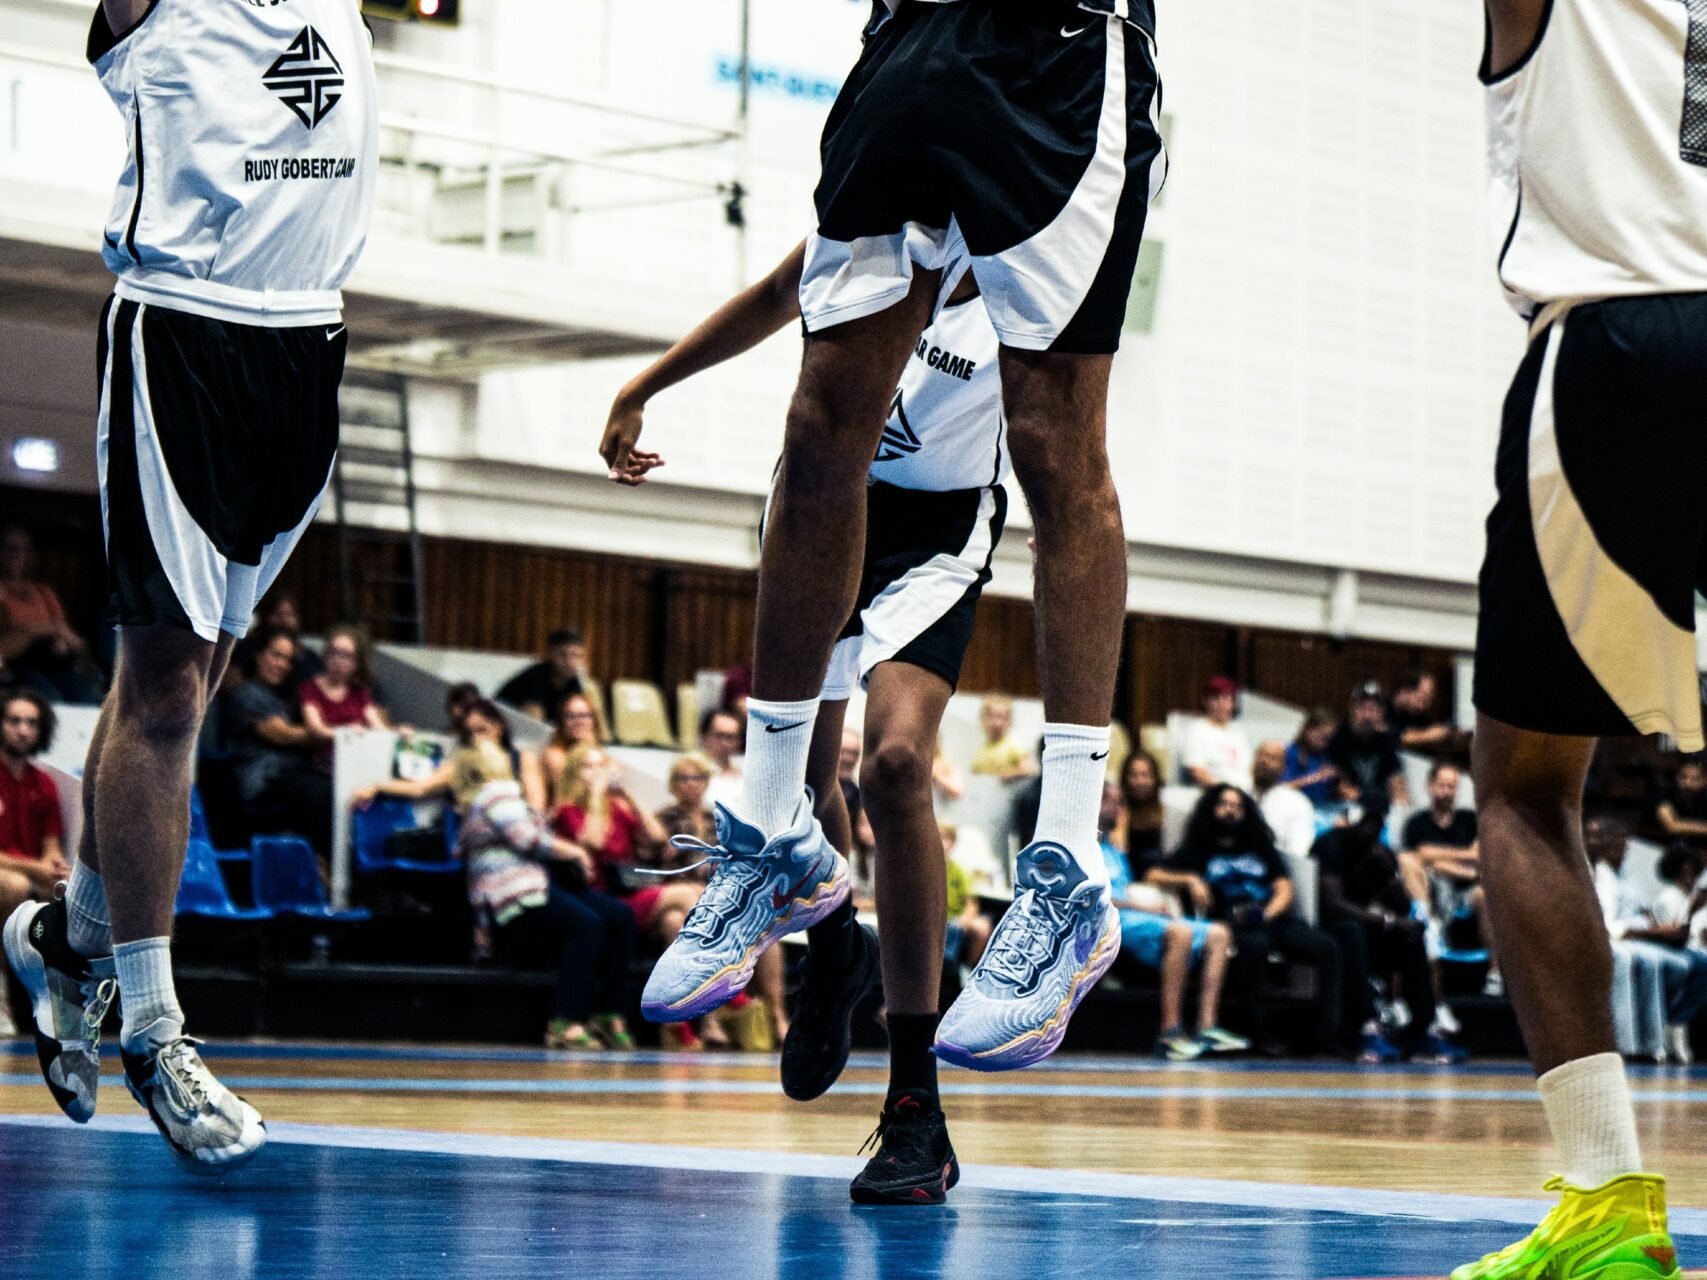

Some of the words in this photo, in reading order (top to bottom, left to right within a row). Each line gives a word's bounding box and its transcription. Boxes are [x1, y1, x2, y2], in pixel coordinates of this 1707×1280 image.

[244, 158, 279, 182] RUDY
[281, 157, 336, 179] GOBERT
[926, 345, 977, 381] GAME
